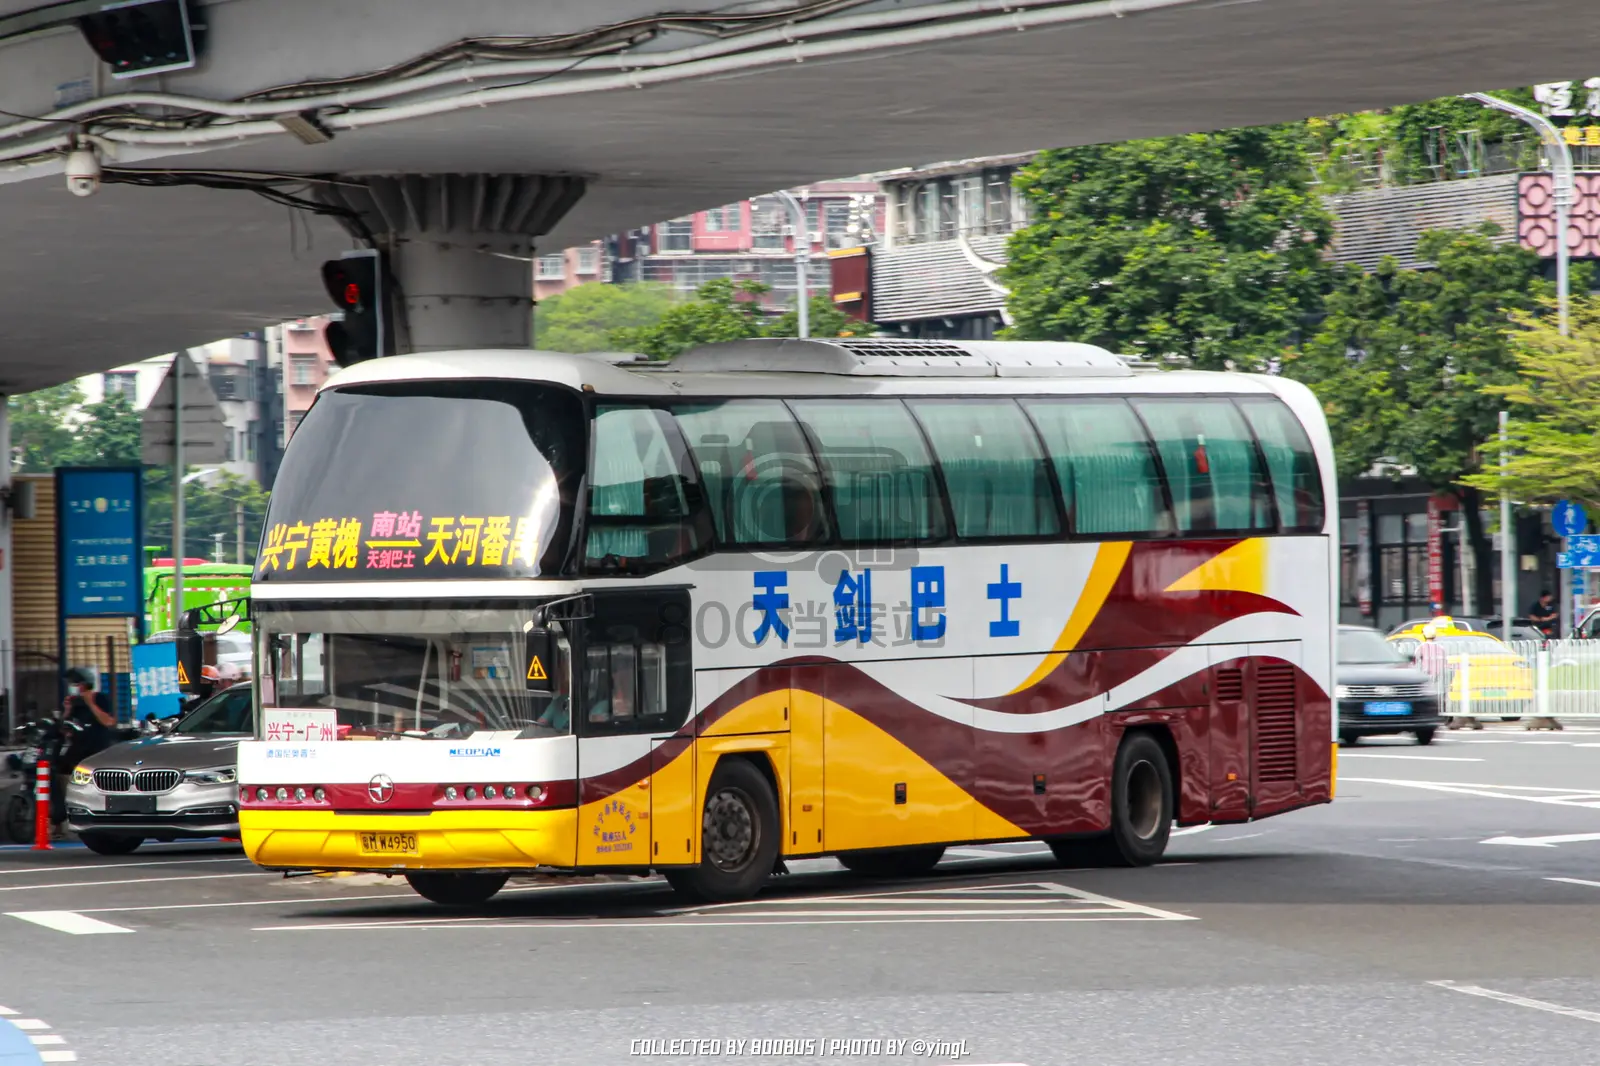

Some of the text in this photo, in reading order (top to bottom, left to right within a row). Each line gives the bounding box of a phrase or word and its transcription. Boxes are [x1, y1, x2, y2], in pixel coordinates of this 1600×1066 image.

[370, 511, 423, 538] 南站
[260, 518, 362, 571] 兴宁黄槐
[366, 550, 416, 569] 天剑巴士
[753, 564, 1022, 643] 天剑巴士
[449, 748, 501, 757] NEOPLAN
